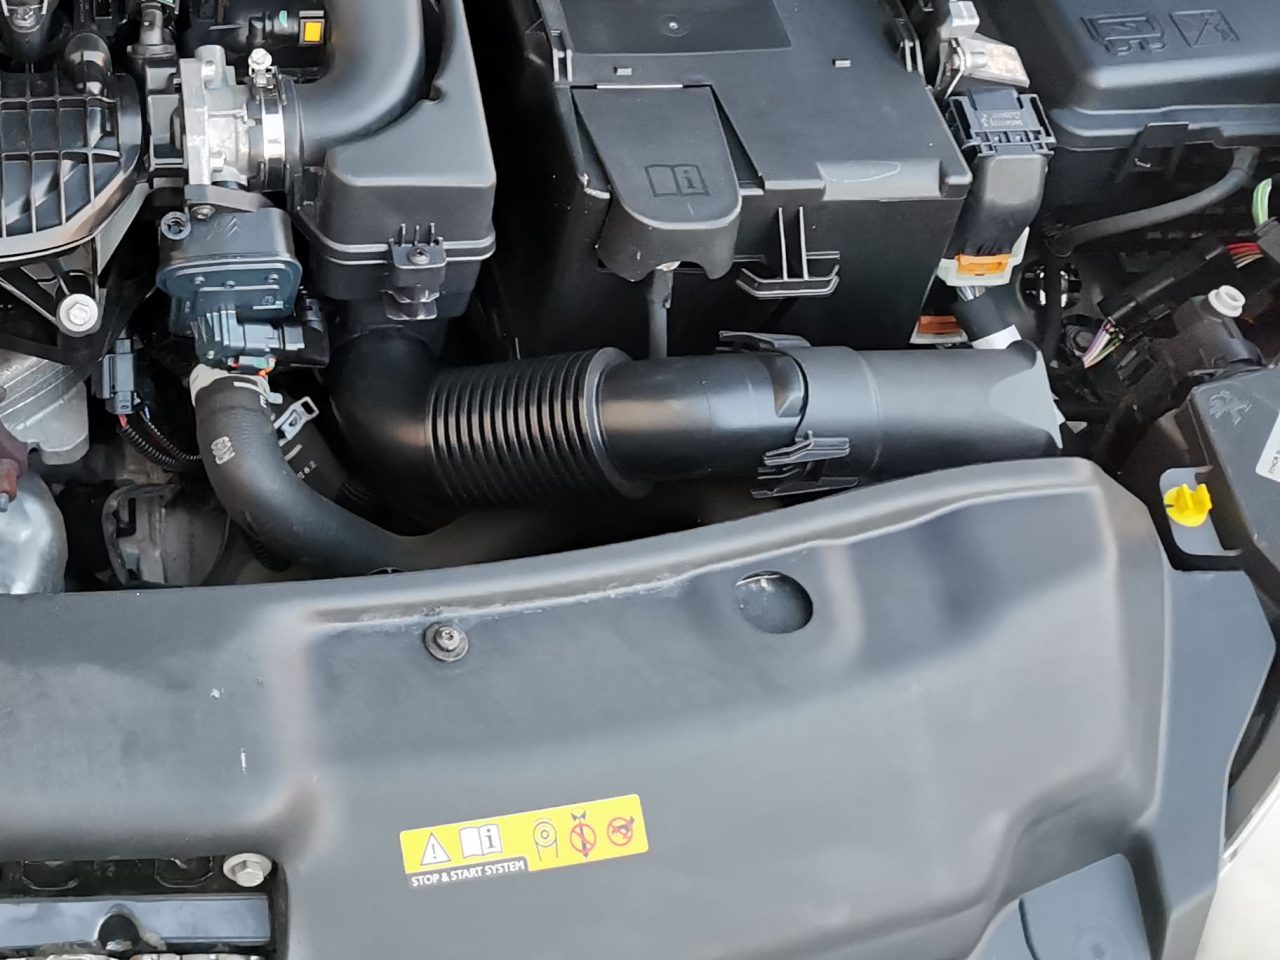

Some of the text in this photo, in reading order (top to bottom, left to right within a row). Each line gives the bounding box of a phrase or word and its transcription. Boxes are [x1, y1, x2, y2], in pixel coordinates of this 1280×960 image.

[411, 860, 525, 887] STOP & START SYSTEM
